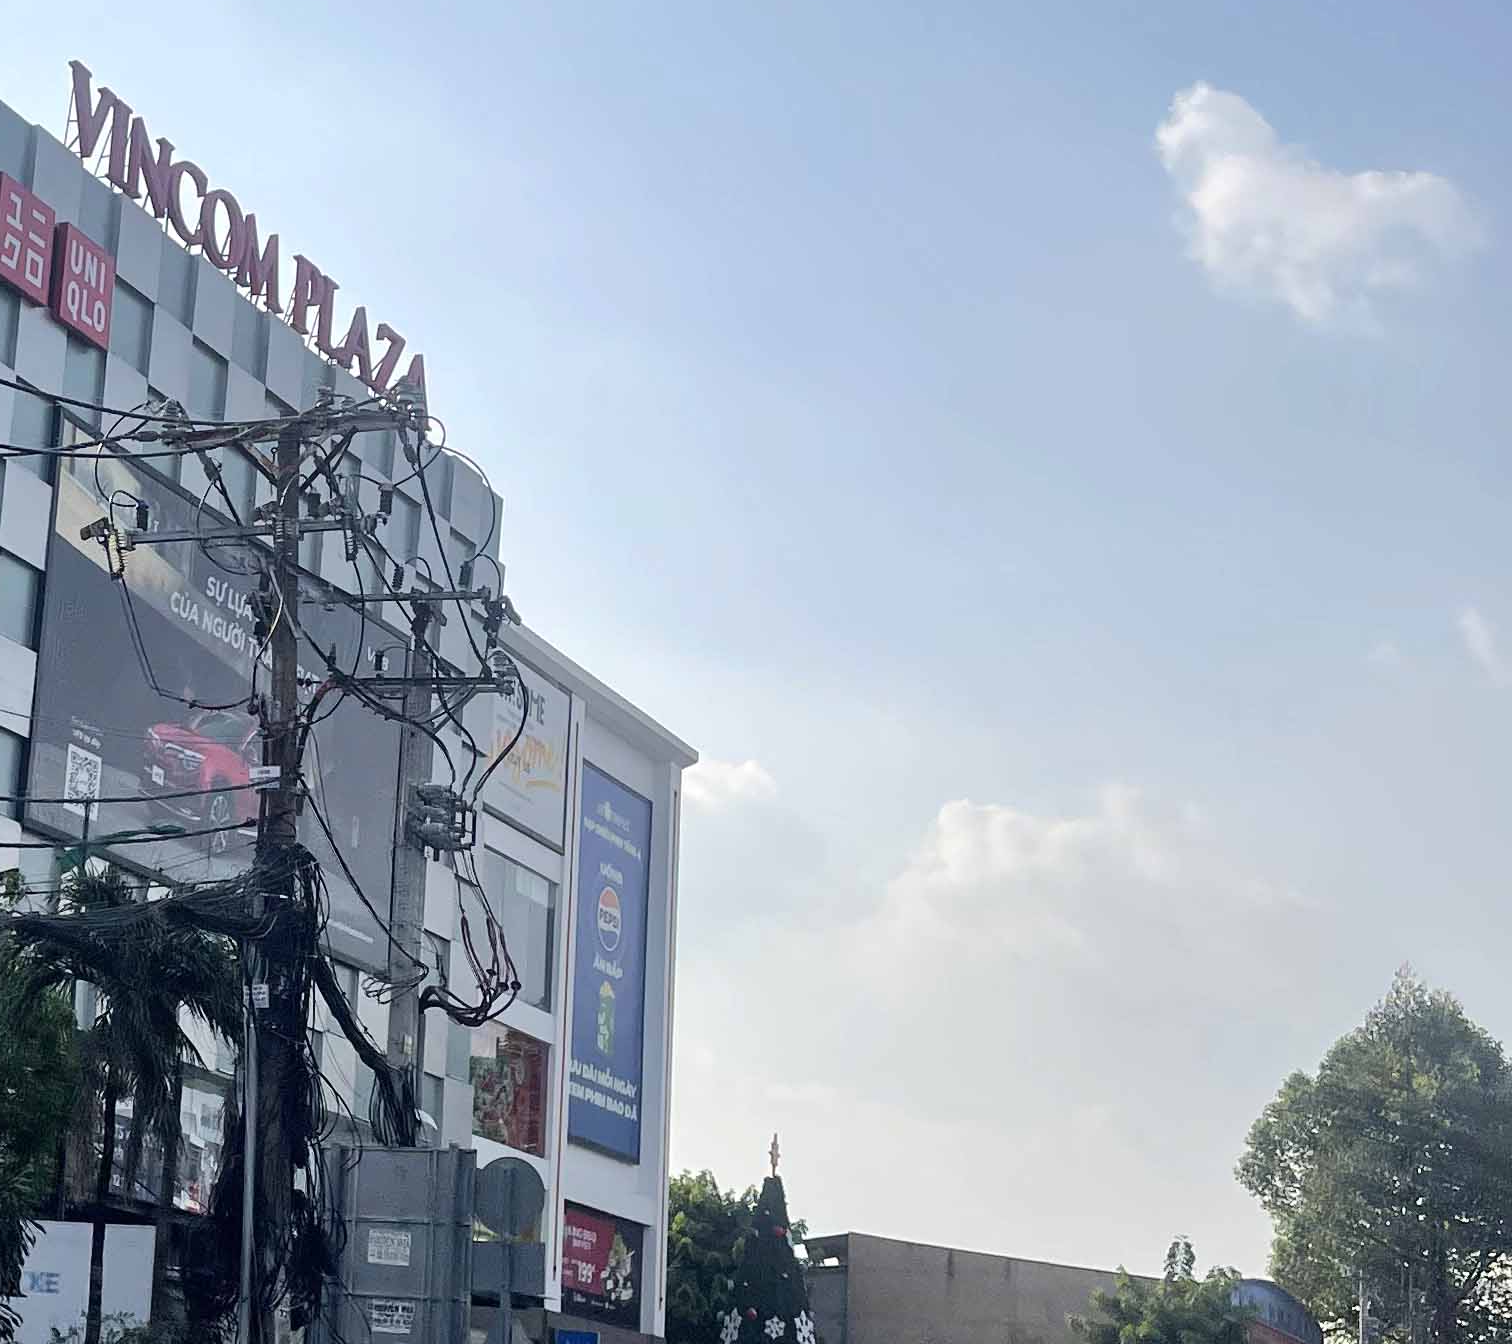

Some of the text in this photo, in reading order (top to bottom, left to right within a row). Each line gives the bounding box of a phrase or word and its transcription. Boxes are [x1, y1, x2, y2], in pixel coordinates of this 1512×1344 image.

[68, 59, 433, 431] VINCOM PLAZA
[70, 239, 106, 295] UNI
[67, 280, 106, 333] QLO
[206, 576, 228, 608] SỰ
[169, 590, 199, 627] CỦA
[201, 609, 248, 654] NGƯỜI
[599, 908, 620, 929] PEPSI
